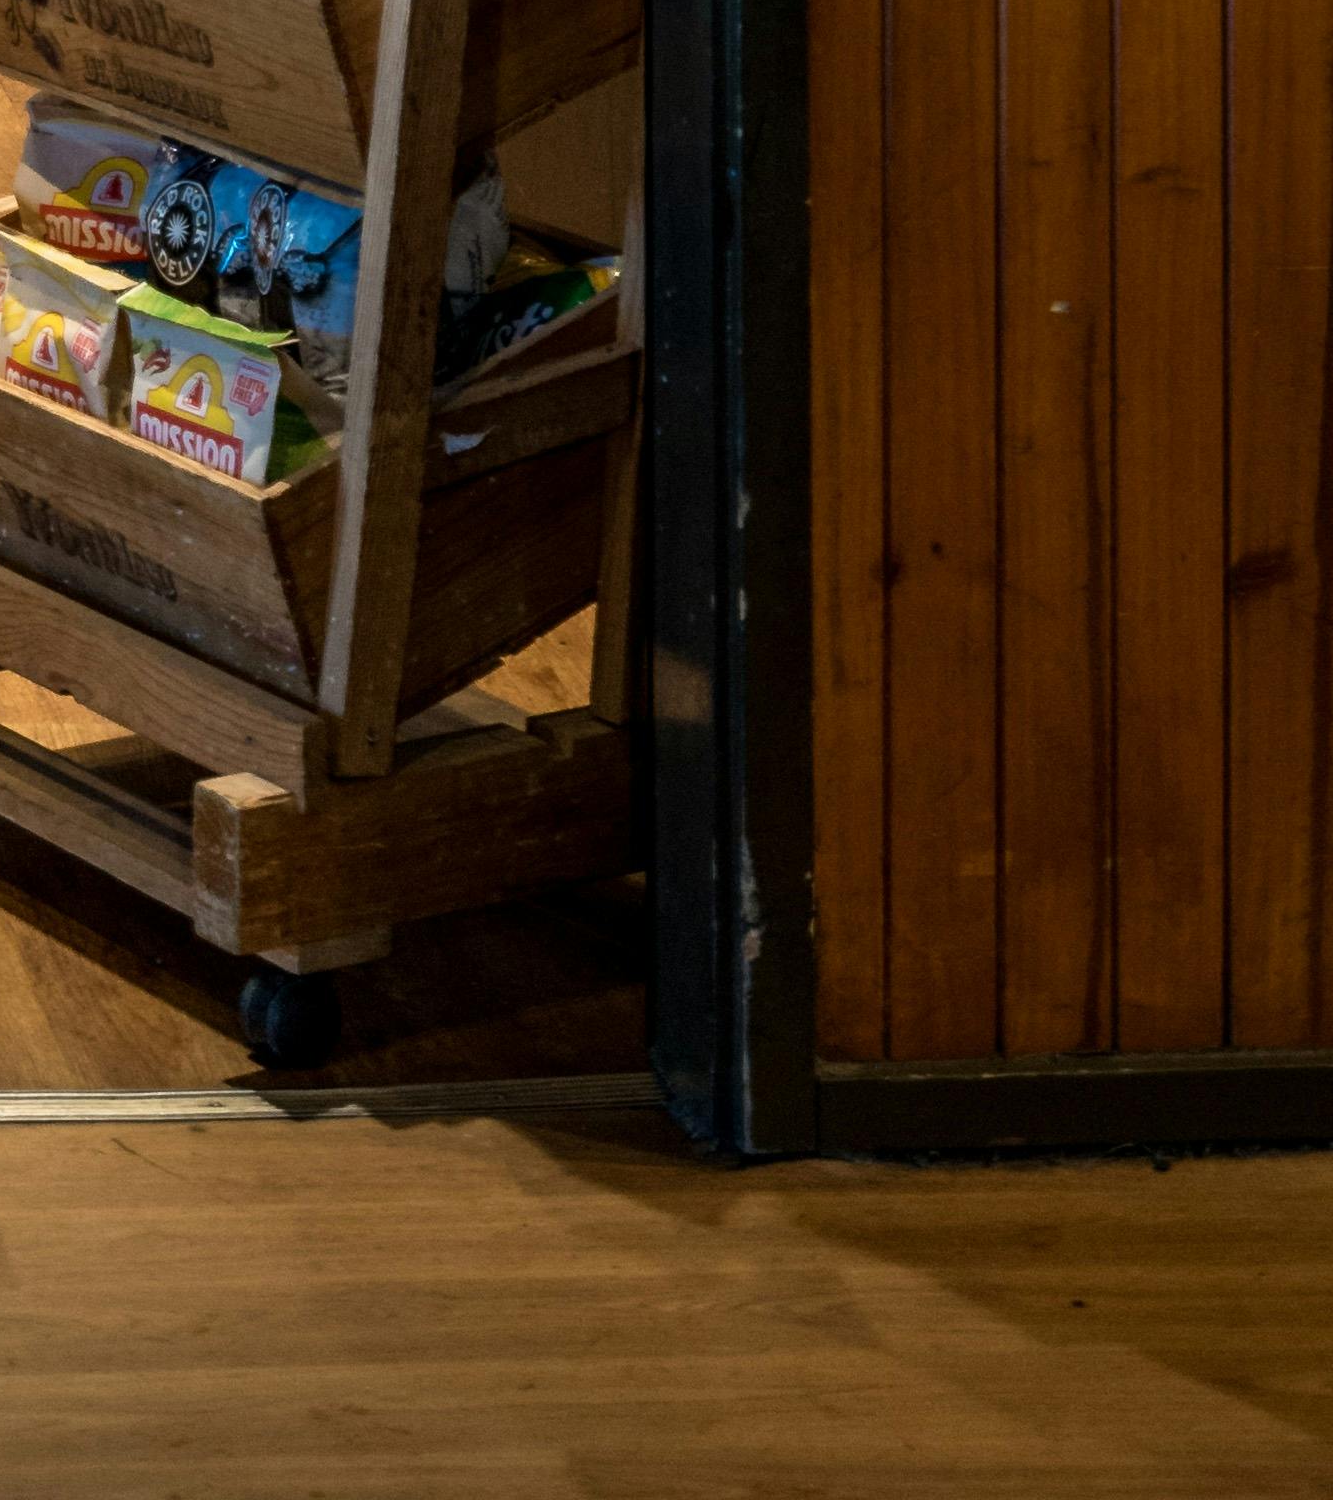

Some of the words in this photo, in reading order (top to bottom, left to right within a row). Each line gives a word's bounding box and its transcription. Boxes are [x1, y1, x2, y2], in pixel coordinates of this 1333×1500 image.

[42, 214, 147, 255] MISSIO
[150, 188, 179, 235] RED
[182, 186, 208, 247] ROCK
[157, 248, 193, 279] DELI
[139, 411, 238, 476] MISSION
